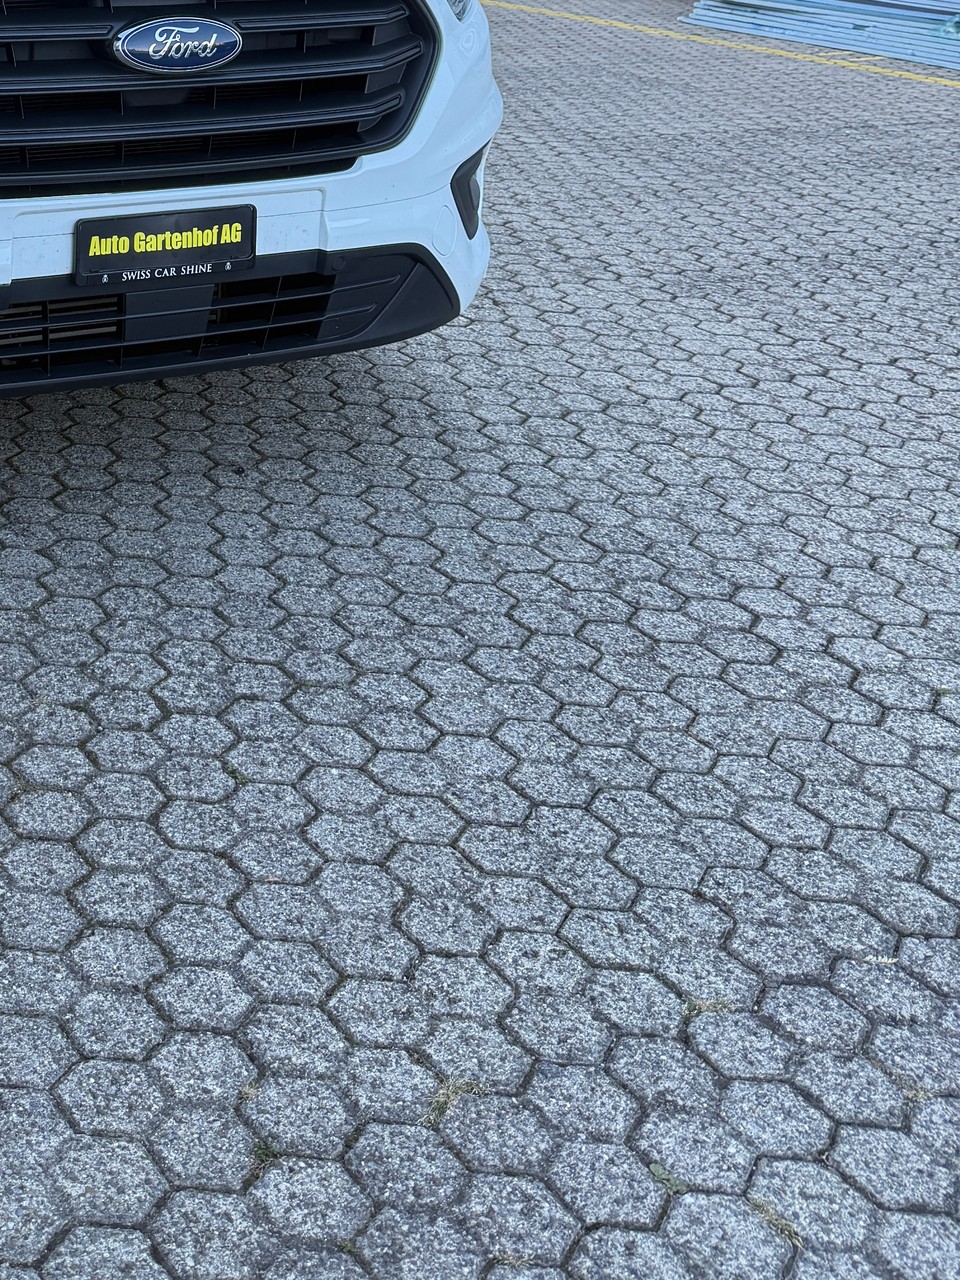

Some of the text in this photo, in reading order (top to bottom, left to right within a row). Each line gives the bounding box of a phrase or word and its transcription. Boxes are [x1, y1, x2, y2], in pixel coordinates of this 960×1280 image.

[148, 26, 218, 60] Ford
[88, 222, 242, 257] Auto Gartenhof AG
[121, 263, 213, 282] SWISS CAR SHINE
